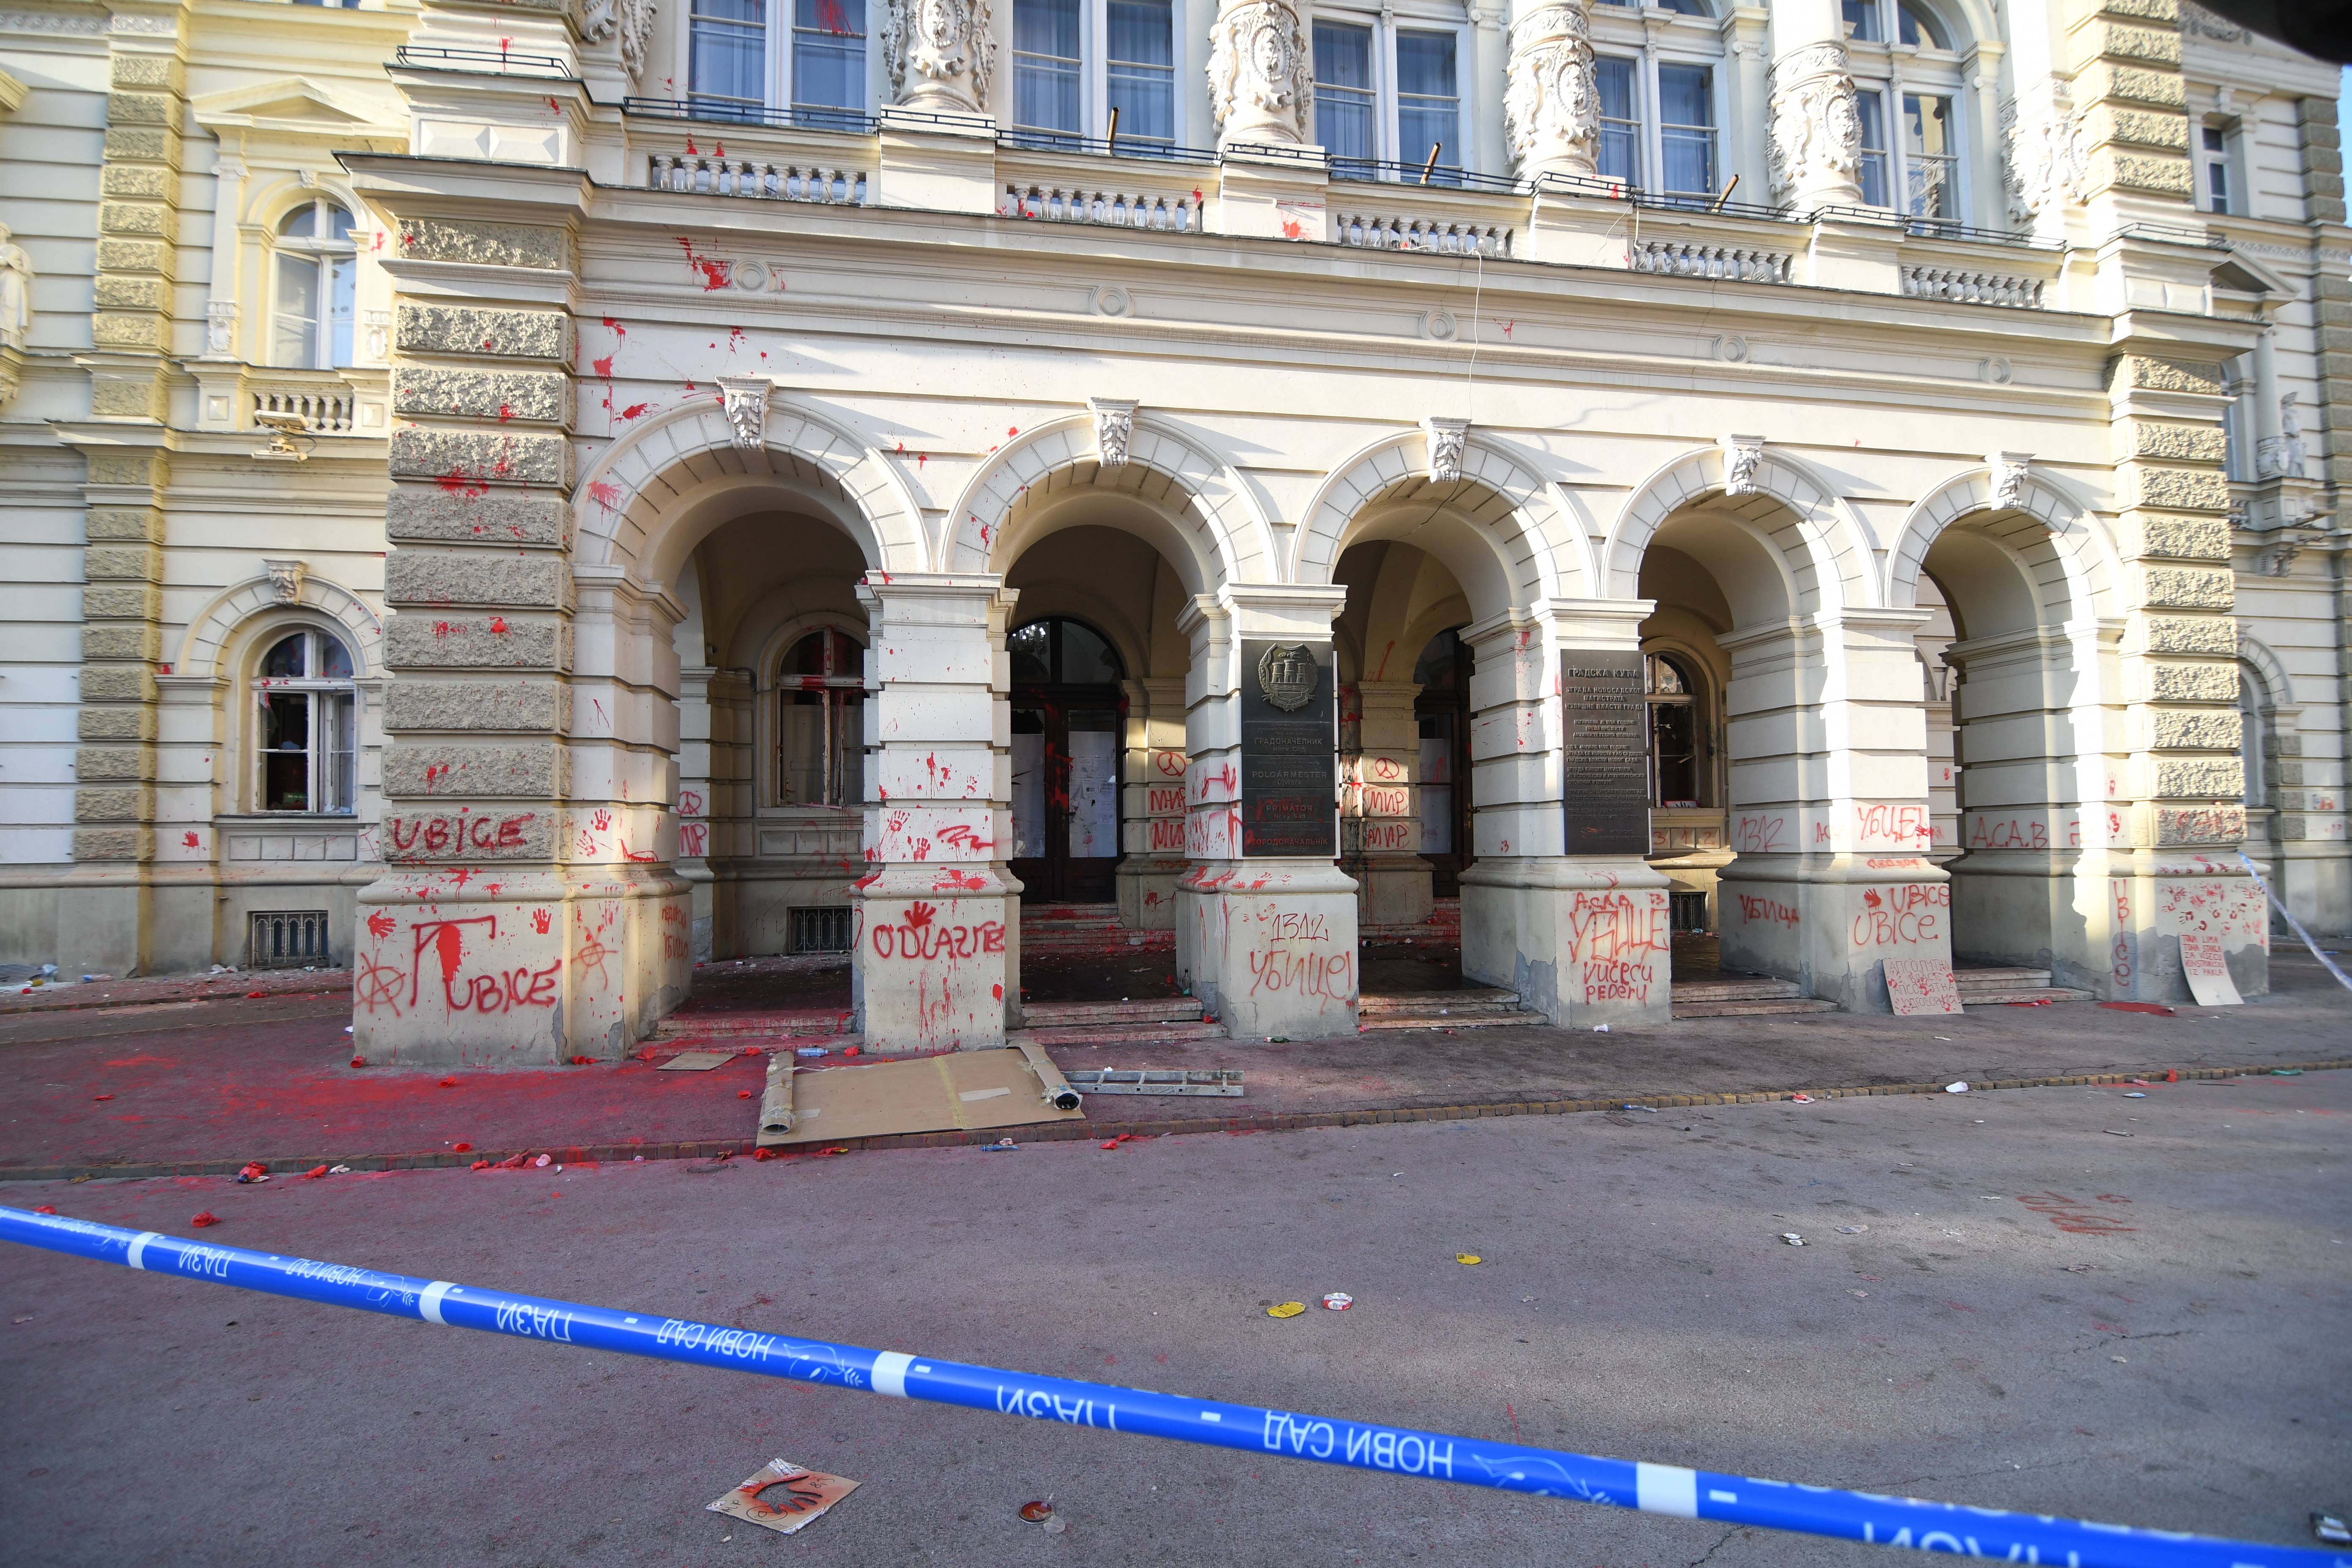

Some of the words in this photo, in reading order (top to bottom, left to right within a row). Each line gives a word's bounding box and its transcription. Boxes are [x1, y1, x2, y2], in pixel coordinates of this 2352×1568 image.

[1568, 668, 1608, 678] ГРАДСКА
[1613, 669, 1639, 678] КУЋА
[1367, 791, 1405, 815] МИР
[393, 812, 536, 853] UBICE
[1367, 824, 1407, 848] МИР
[1271, 912, 1328, 945] 1312
[1889, 959, 1950, 974] АПСОЛУТНА
[444, 959, 562, 1014] UBICE
[1894, 983, 1955, 996] АПСОУТНА
[178, 1244, 235, 1278] ПАЗИ
[285, 1258, 325, 1278] САД
[316, 1262, 369, 1288] НОВИ
[496, 1300, 573, 1342] ПАЗИ
[656, 1318, 706, 1350] САД
[705, 1327, 777, 1362] НОВИ
[1263, 1410, 1335, 1458] САД
[1345, 1426, 1454, 1478] НОВИ
